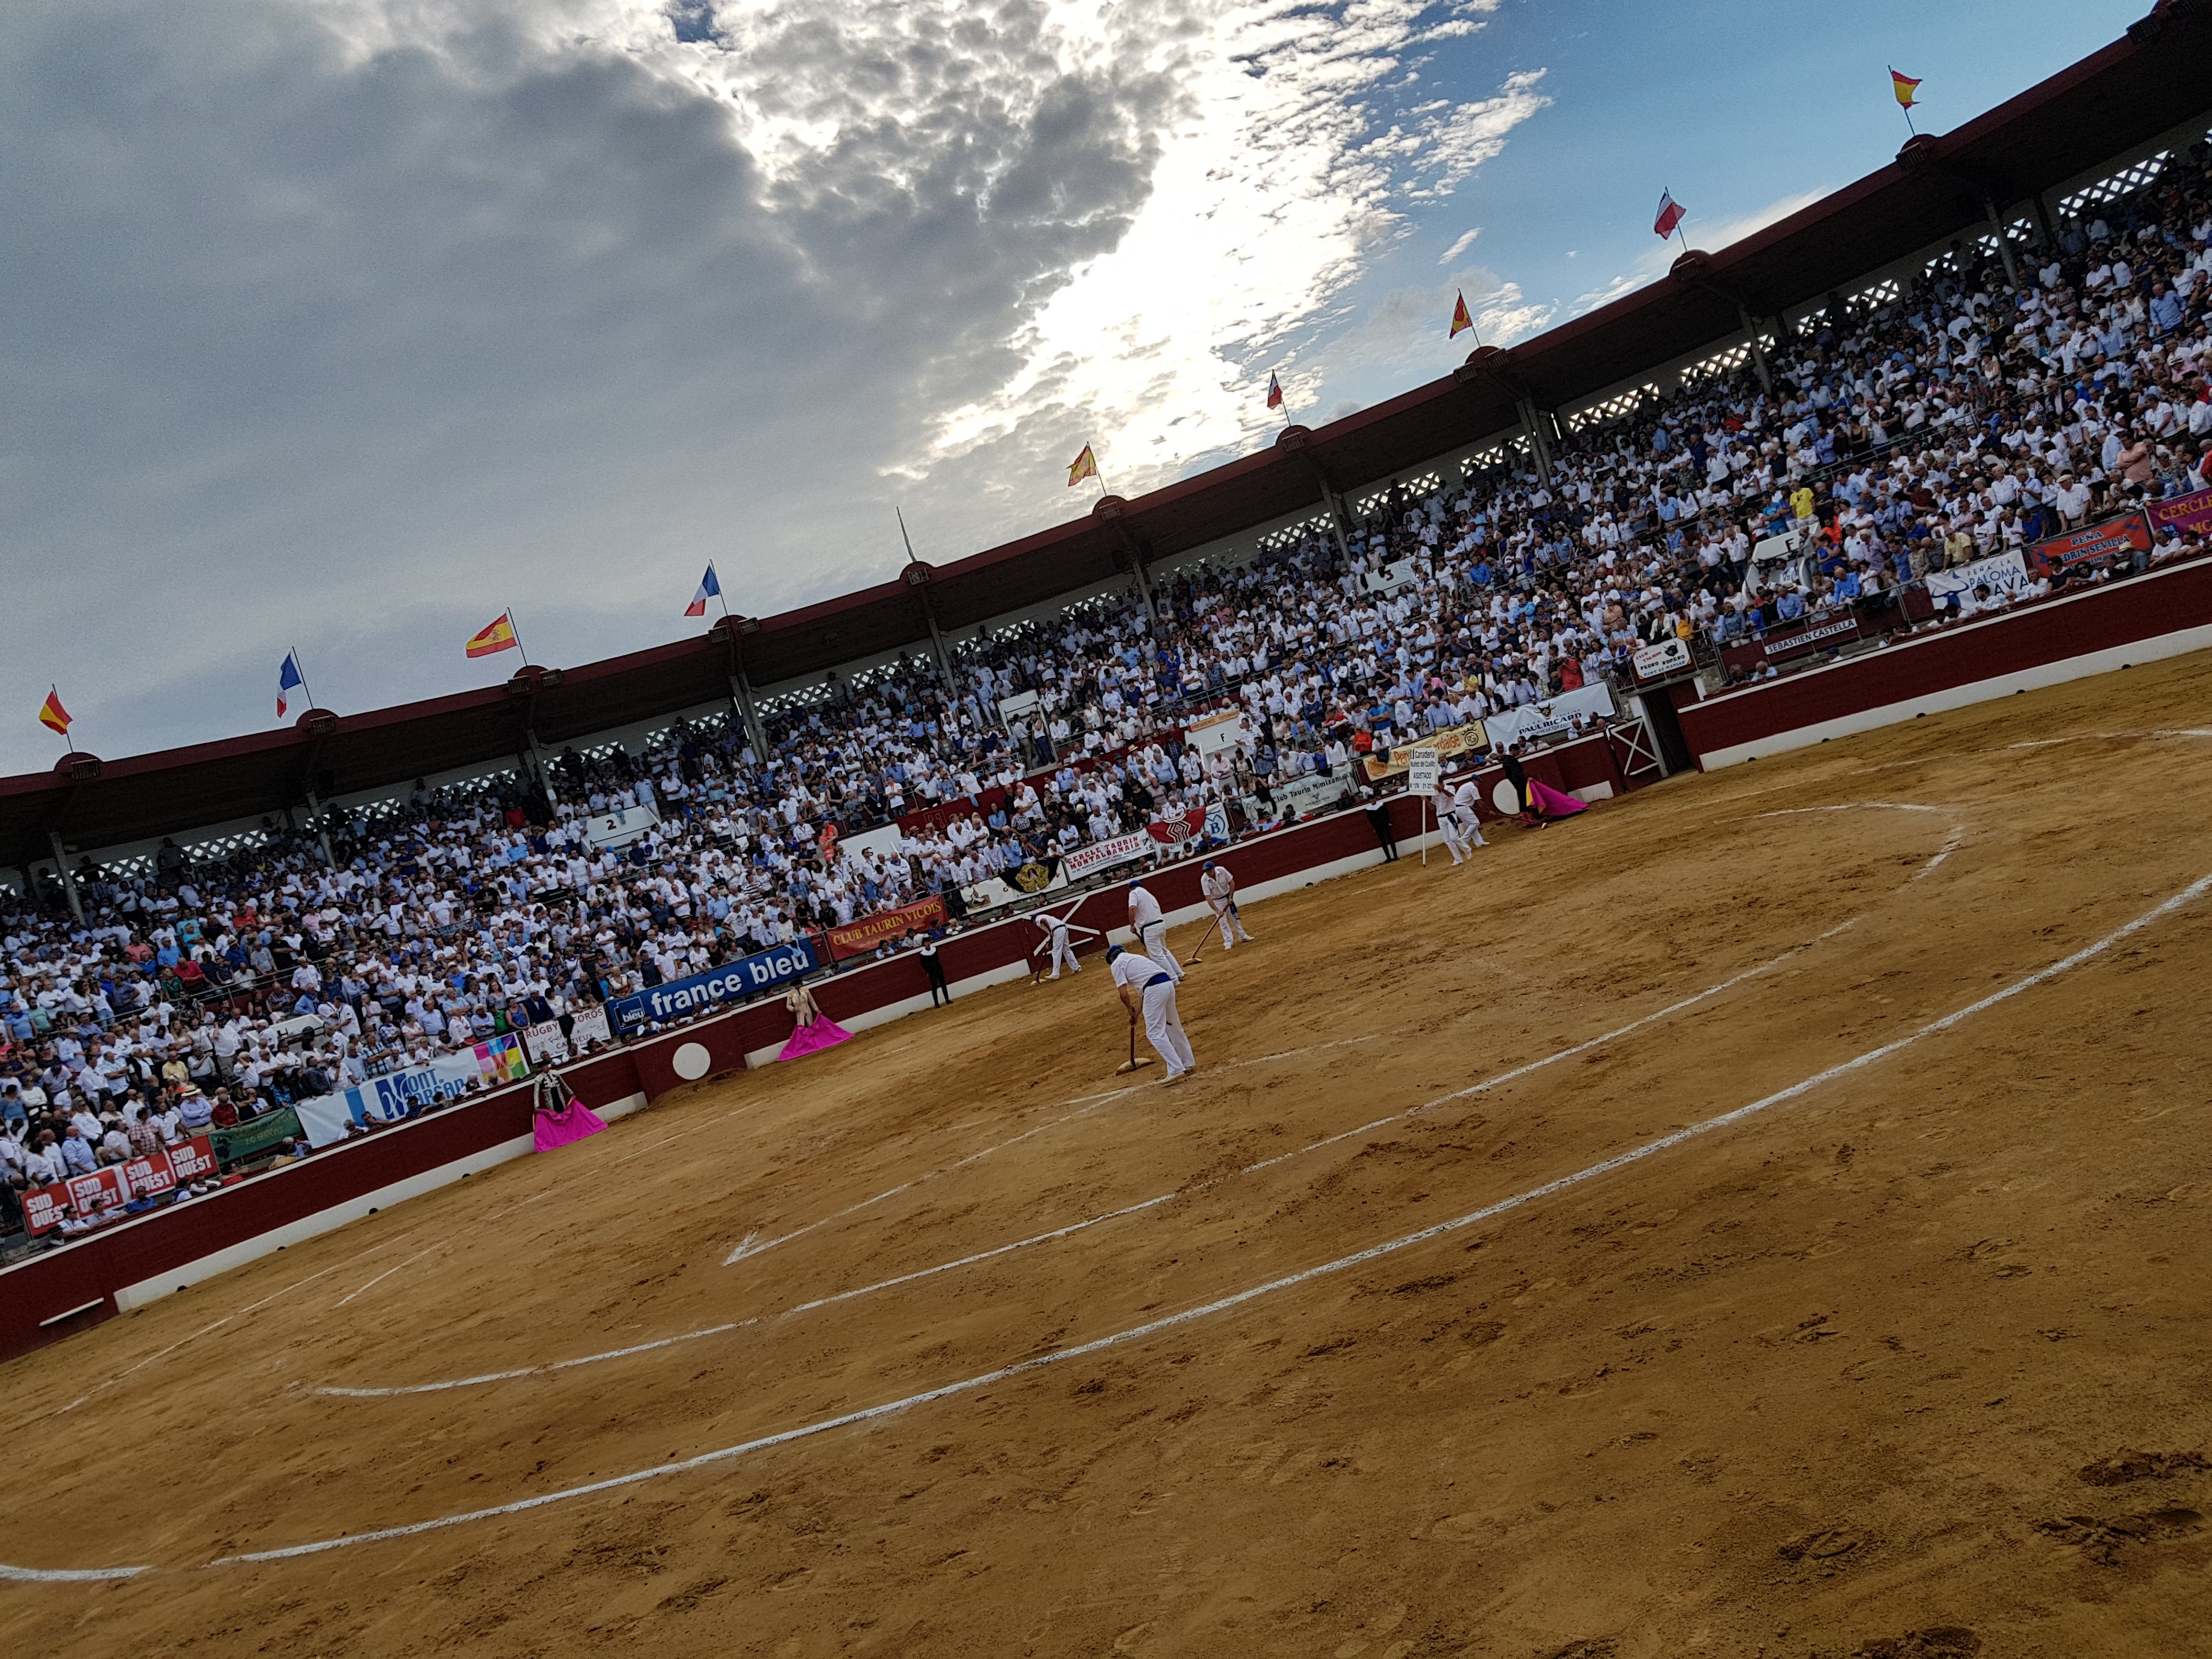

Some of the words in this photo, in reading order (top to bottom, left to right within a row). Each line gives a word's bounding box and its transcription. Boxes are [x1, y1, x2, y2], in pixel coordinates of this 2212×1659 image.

[2071, 531, 2103, 546] PEÑA
[2090, 534, 2131, 554] SEVILLA
[1967, 565, 1992, 577] PEÑA
[1969, 566, 2021, 588] PALOMA
[1768, 634, 1812, 653] SEBASTIEN
[1813, 620, 1854, 638] CASTELLA
[1640, 662, 1659, 670] PEDRO
[1662, 654, 1685, 665] ROMERO
[1519, 724, 1543, 735] PAUL
[1544, 713, 1582, 727] RICARD
[1274, 795, 1288, 803] Club
[1289, 787, 1311, 798] Taurin
[606, 819, 617, 831] 2
[1068, 847, 1102, 864] CERCLE
[1104, 836, 1138, 850] TAURIN
[1070, 842, 1140, 870] MONTALBANAIS
[833, 928, 863, 946] CLUB
[862, 914, 905, 936] TAURIN
[905, 901, 943, 922] VICOIS
[651, 974, 742, 1016] france
[748, 955, 810, 985] bleu
[622, 1009, 644, 1023] bleu
[526, 1022, 558, 1039] RUGBY
[556, 1032, 594, 1049] CATIEUX
[170, 1146, 196, 1165] SUD
[127, 1160, 153, 1180] SUD
[175, 1154, 212, 1178] OUEST
[74, 1177, 102, 1198] SUD
[27, 1193, 53, 1214] SUD
